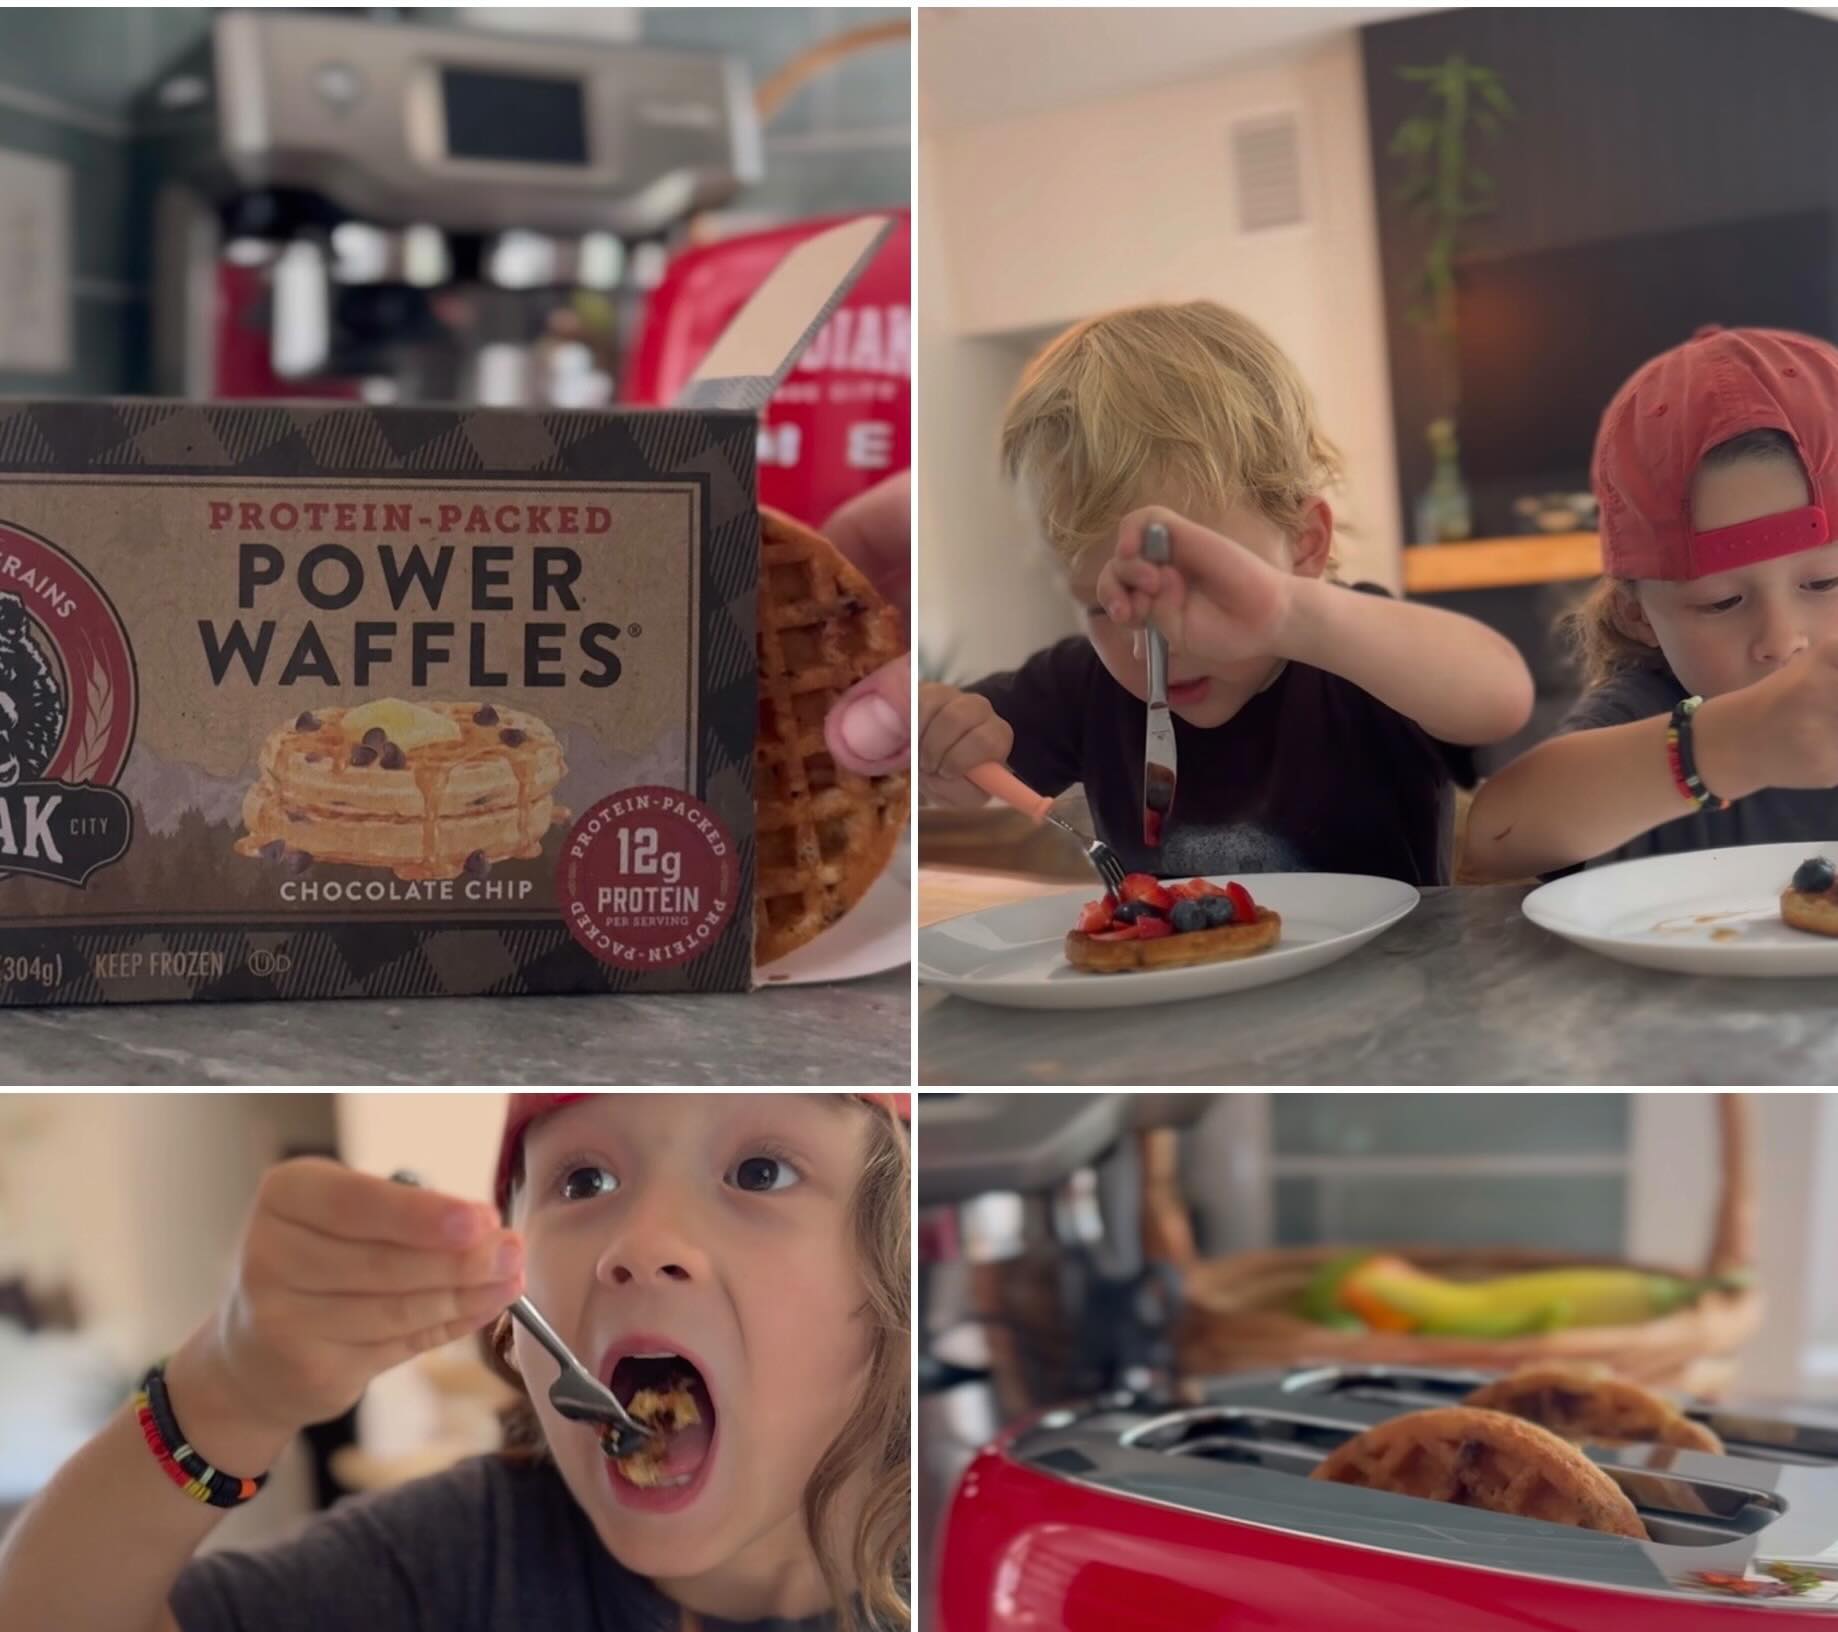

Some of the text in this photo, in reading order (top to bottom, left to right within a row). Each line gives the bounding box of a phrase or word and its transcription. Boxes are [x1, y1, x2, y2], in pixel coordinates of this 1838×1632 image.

[209, 502, 613, 535] PROTEIN-PACKED
[0, 552, 77, 617] RAINS
[238, 543, 584, 612] POWER
[70, 818, 108, 835] CITY
[571, 795, 727, 859] PROTEIN-PACKED
[617, 827, 681, 884] 12g
[279, 880, 534, 901] CHOCOLATE CHIP
[598, 887, 699, 913] PROTEIN
[606, 916, 689, 927] PER SERVING
[0, 952, 223, 987] 304g) KEEP FROZEN
